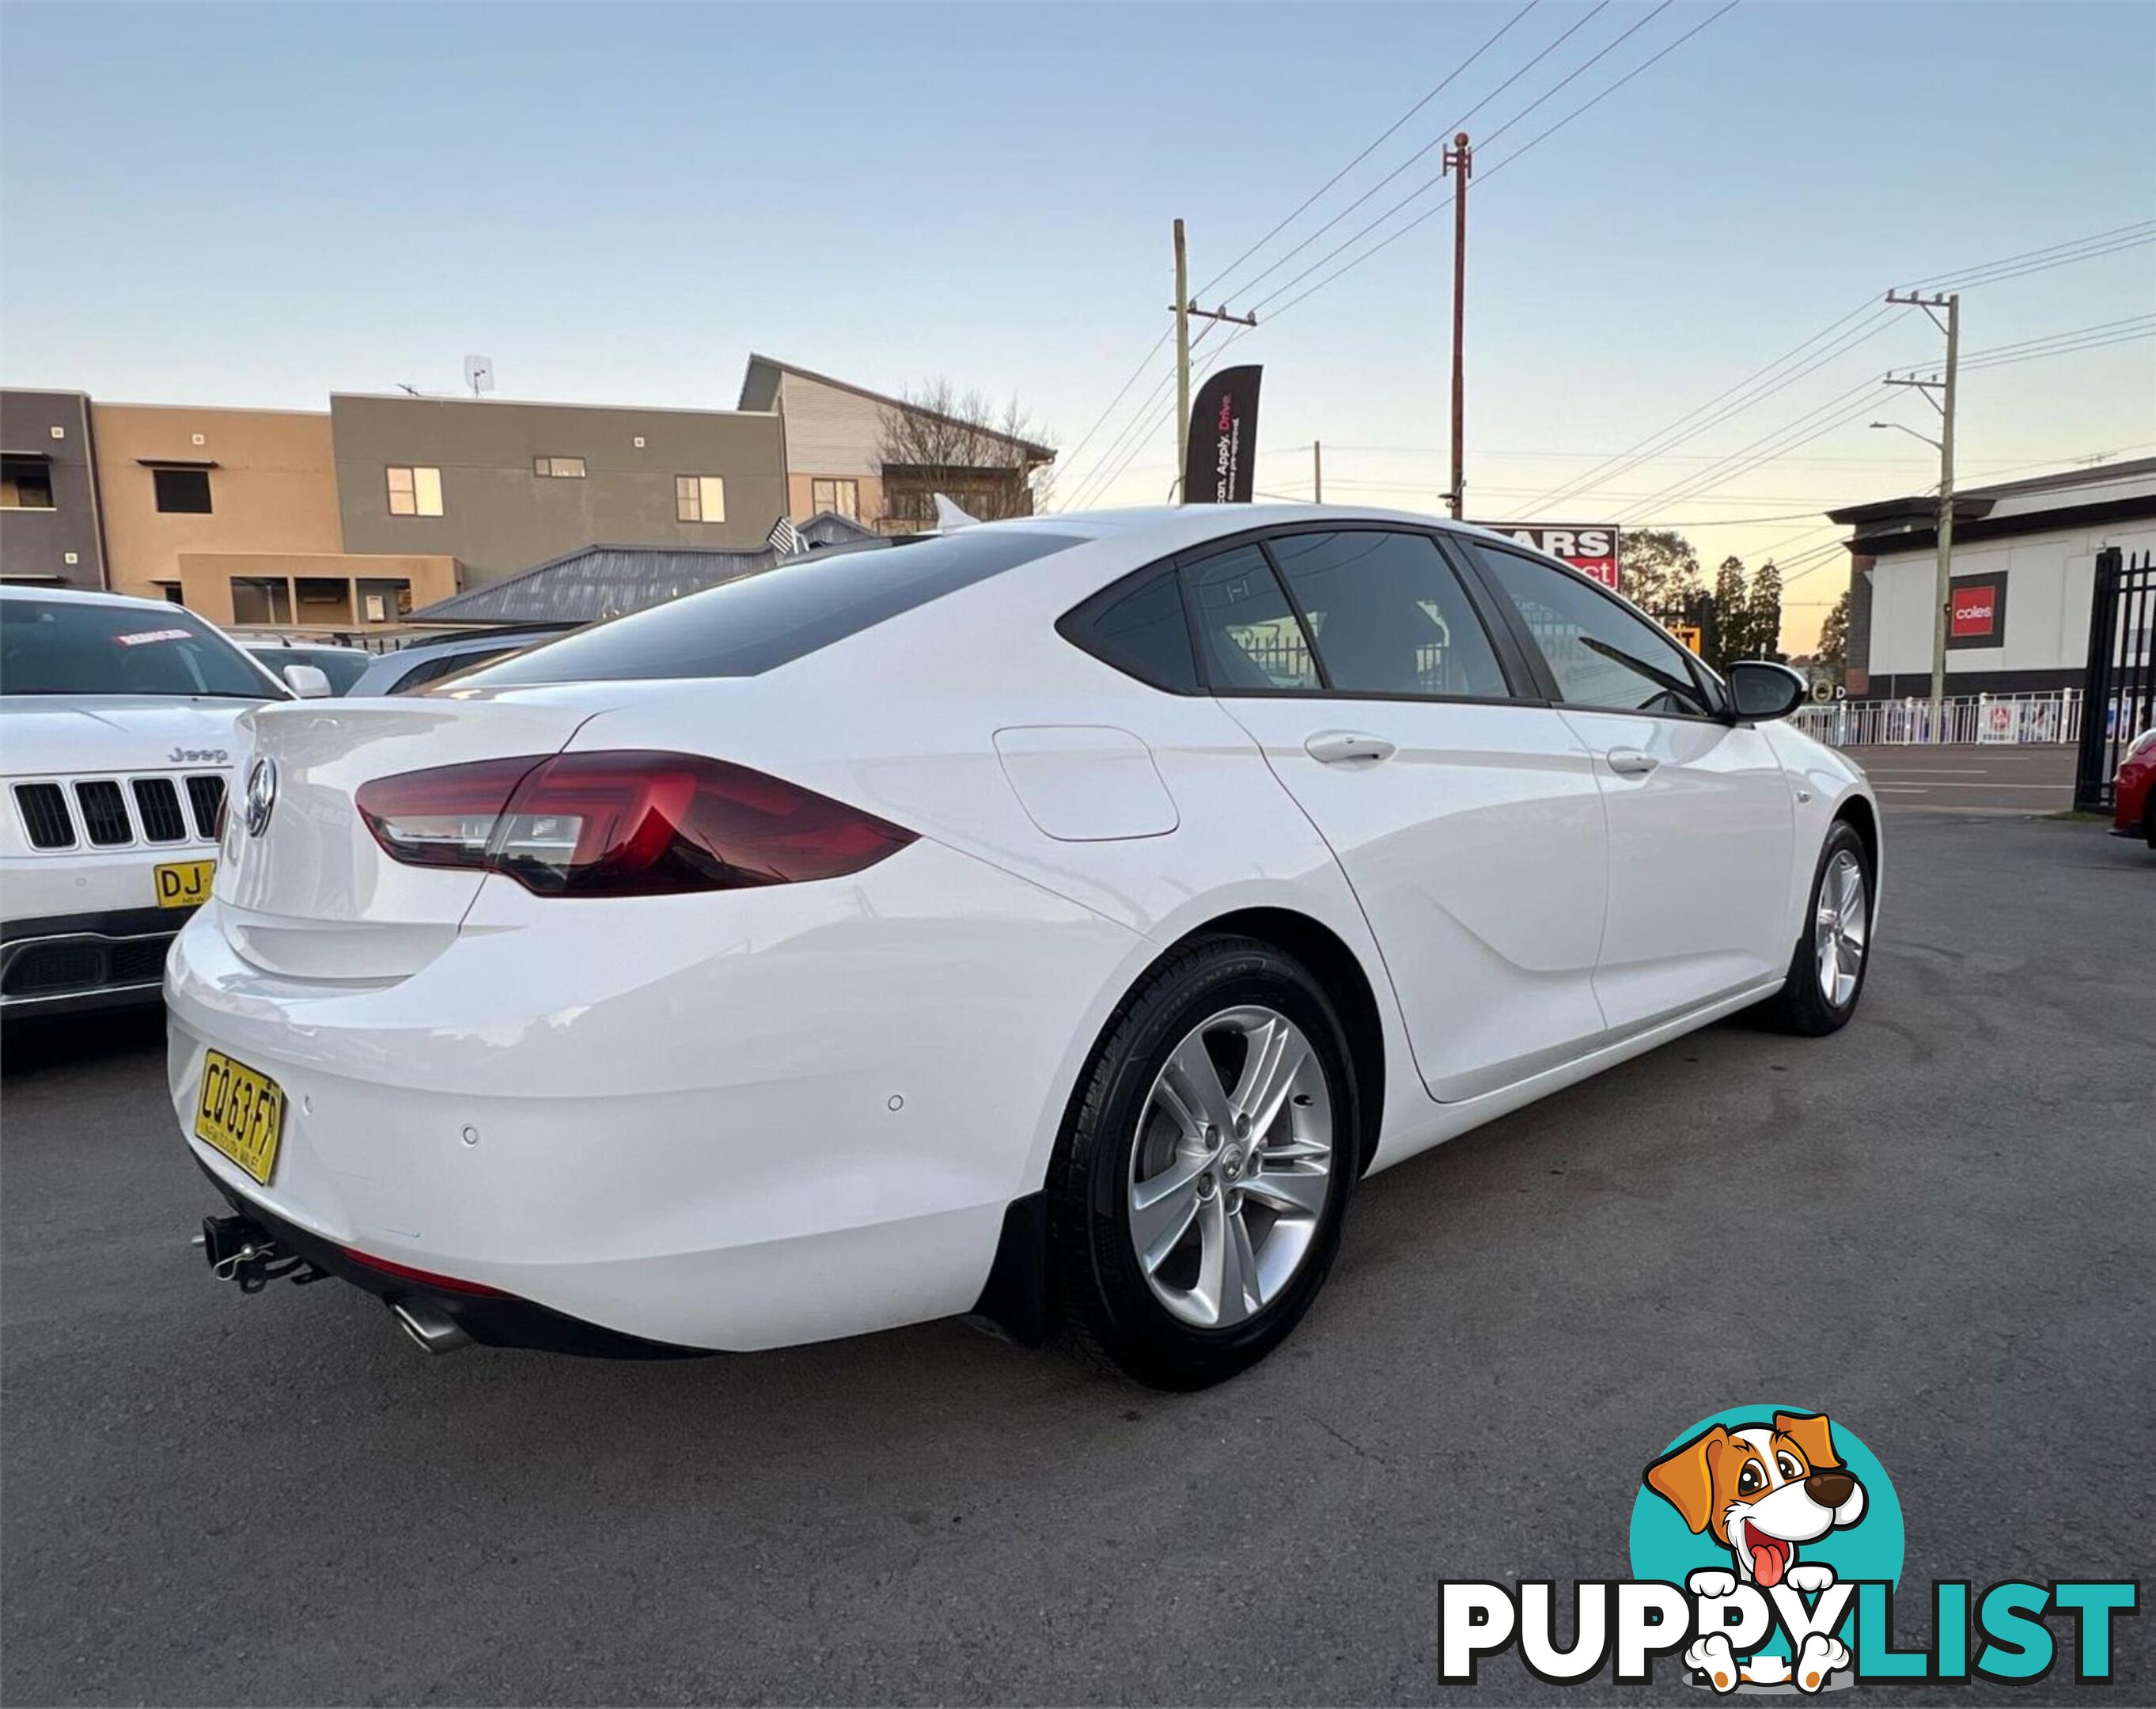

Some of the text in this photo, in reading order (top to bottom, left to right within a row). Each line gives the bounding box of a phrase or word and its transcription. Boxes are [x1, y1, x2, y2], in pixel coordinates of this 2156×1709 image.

[1217, 434, 1231, 476] Apply.
[1956, 605, 1991, 620] coles
[168, 748, 228, 764] Jeep
